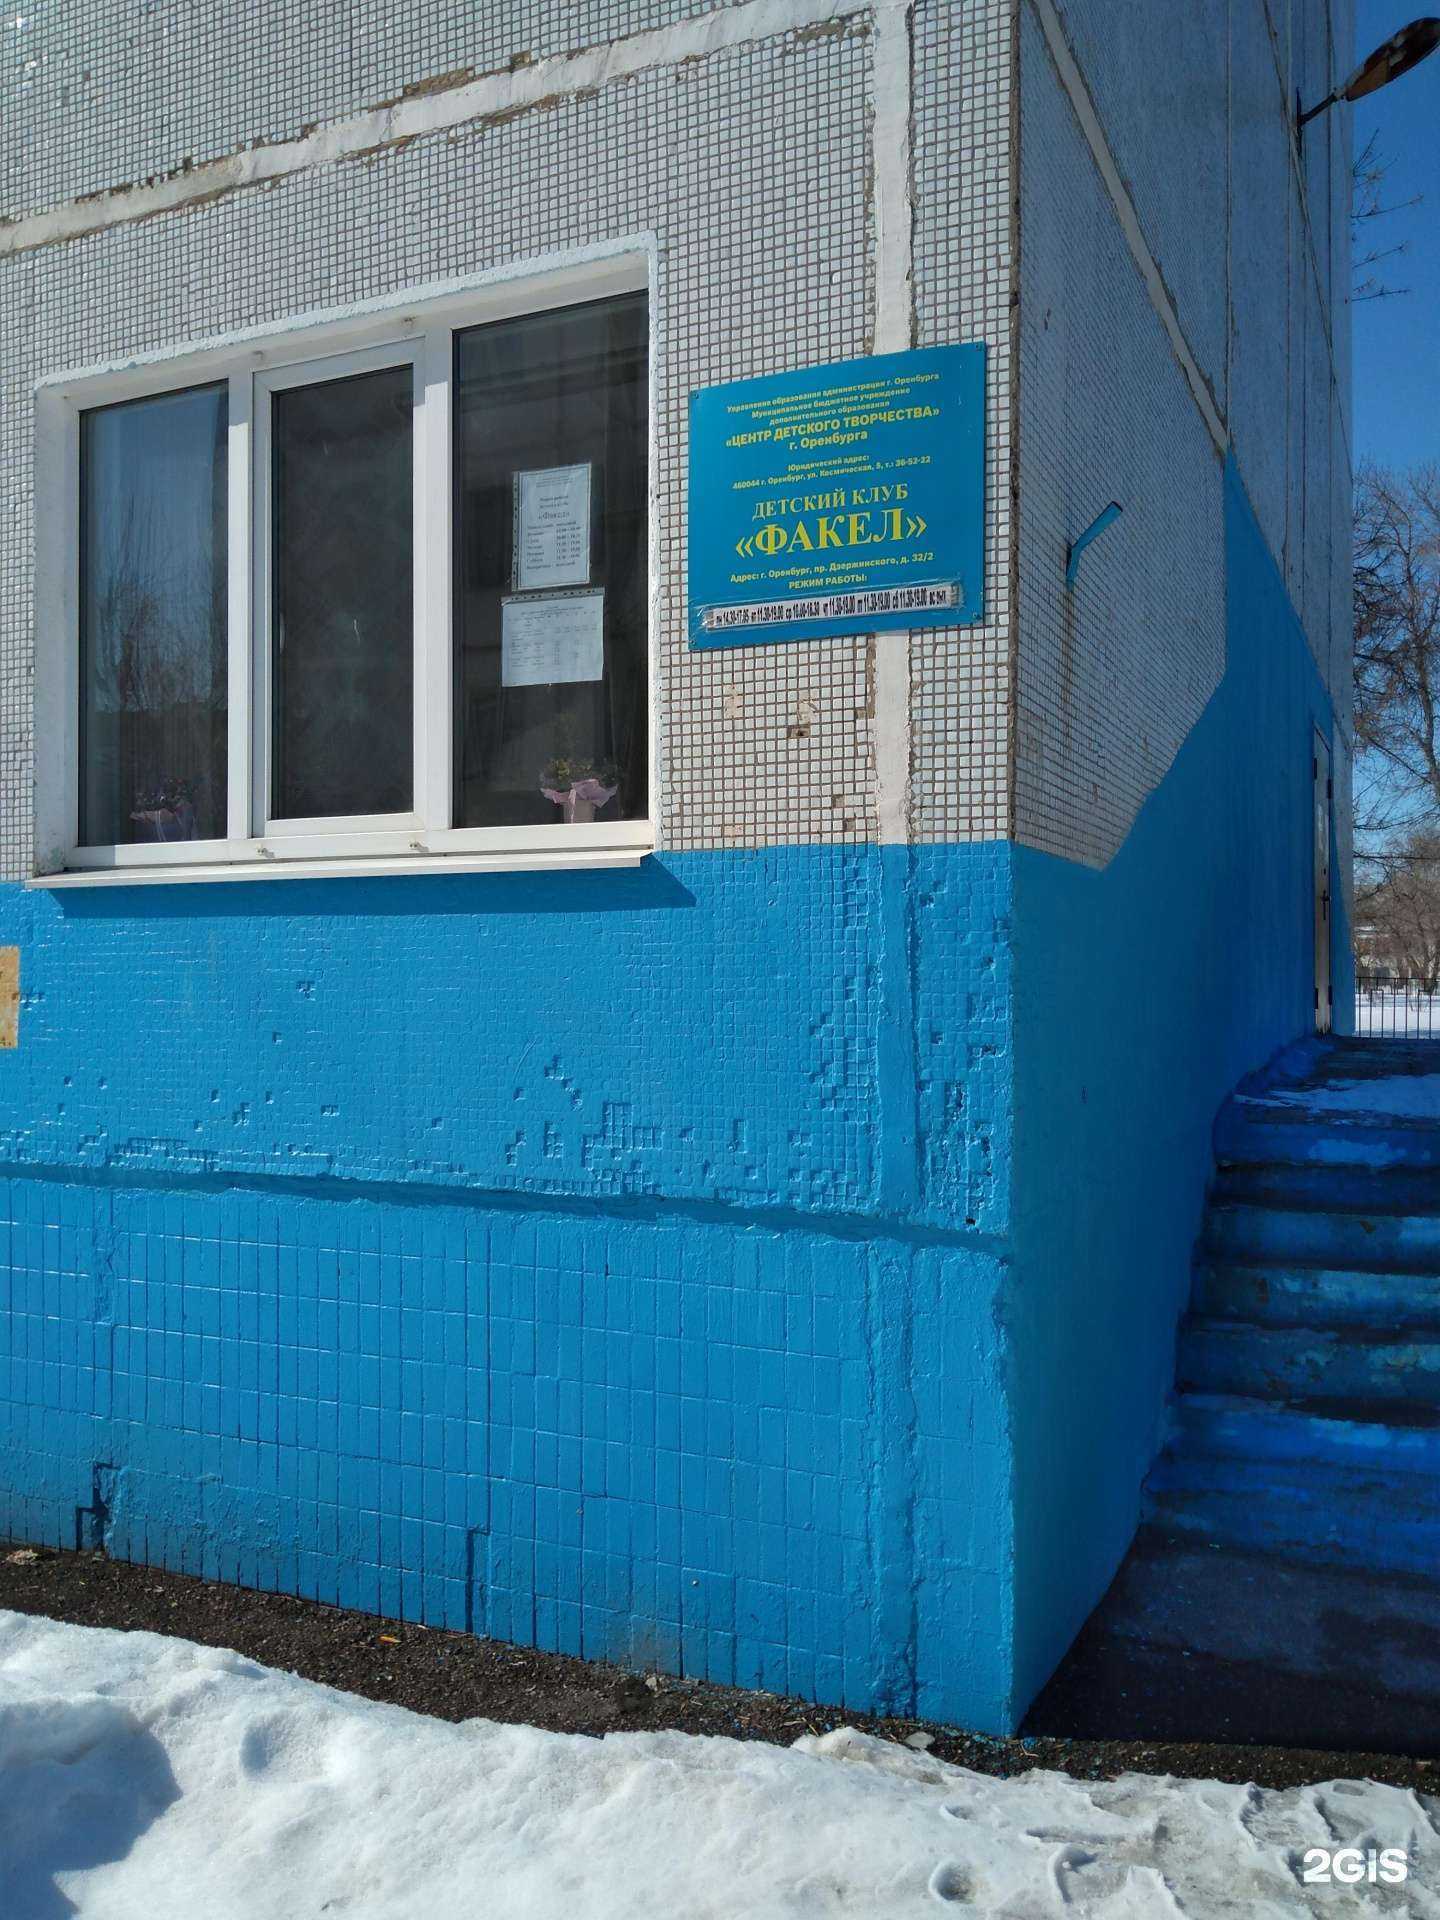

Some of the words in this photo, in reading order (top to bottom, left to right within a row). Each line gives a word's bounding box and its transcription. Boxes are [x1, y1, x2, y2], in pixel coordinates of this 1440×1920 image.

[894, 373, 939, 385] Оренбурга
[726, 430, 772, 447] «ЦЕНТР
[773, 418, 841, 442] ДЕТСКОГО
[843, 405, 940, 427] ТВОРЧЕСТВА»
[789, 441, 798, 450] г.
[800, 429, 868, 449] Оренбурга
[807, 471, 819, 480] ул.
[752, 488, 845, 521] ДЕТСКИЙ
[852, 483, 908, 505] КЛУБ
[735, 507, 928, 558] «ФАКЕЛ»
[730, 572, 760, 583] Адрес:
[768, 566, 813, 579] Оренбург,
[814, 564, 828, 575] пр.
[911, 552, 934, 562] 32/2
[788, 579, 824, 590] РЕЖИМ
